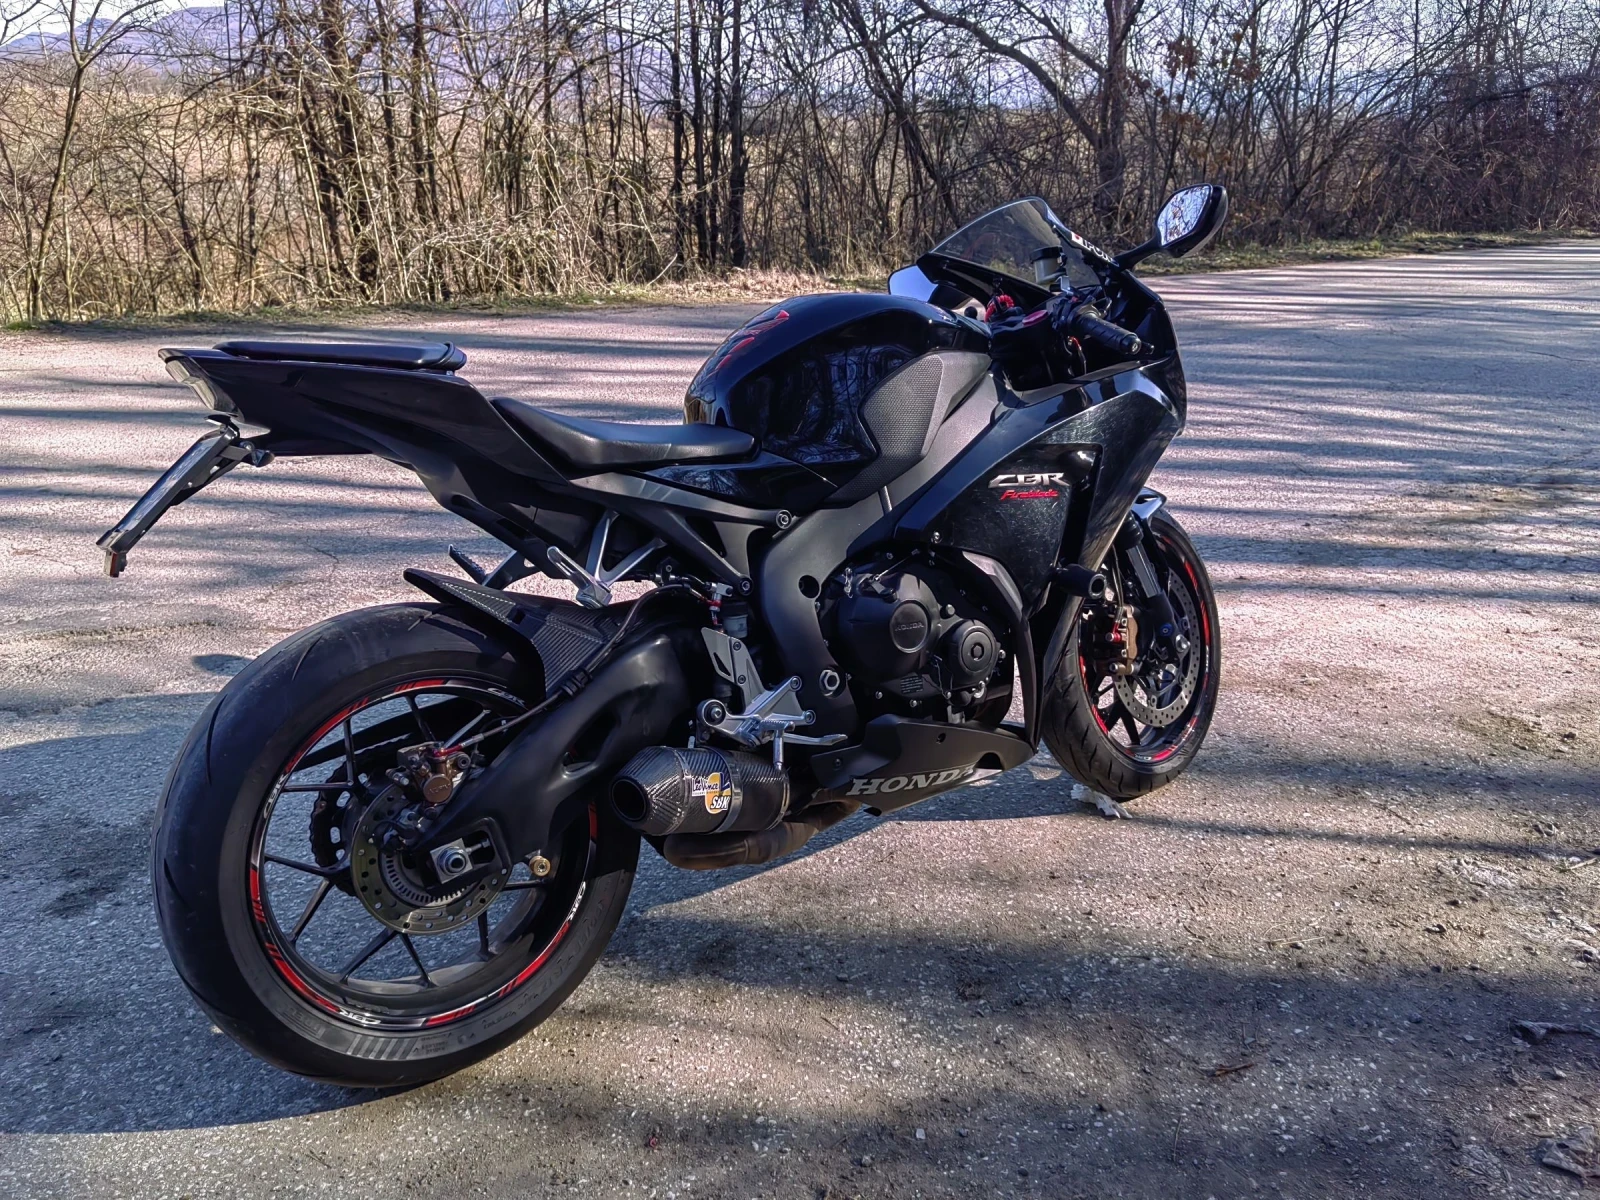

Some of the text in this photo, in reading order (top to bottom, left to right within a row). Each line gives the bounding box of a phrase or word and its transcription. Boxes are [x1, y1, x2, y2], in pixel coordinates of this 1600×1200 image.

[988, 473, 1071, 488] CBR
[846, 764, 975, 796] HONDA
[711, 796, 730, 809] SBK
[339, 1007, 382, 1025] CBR
